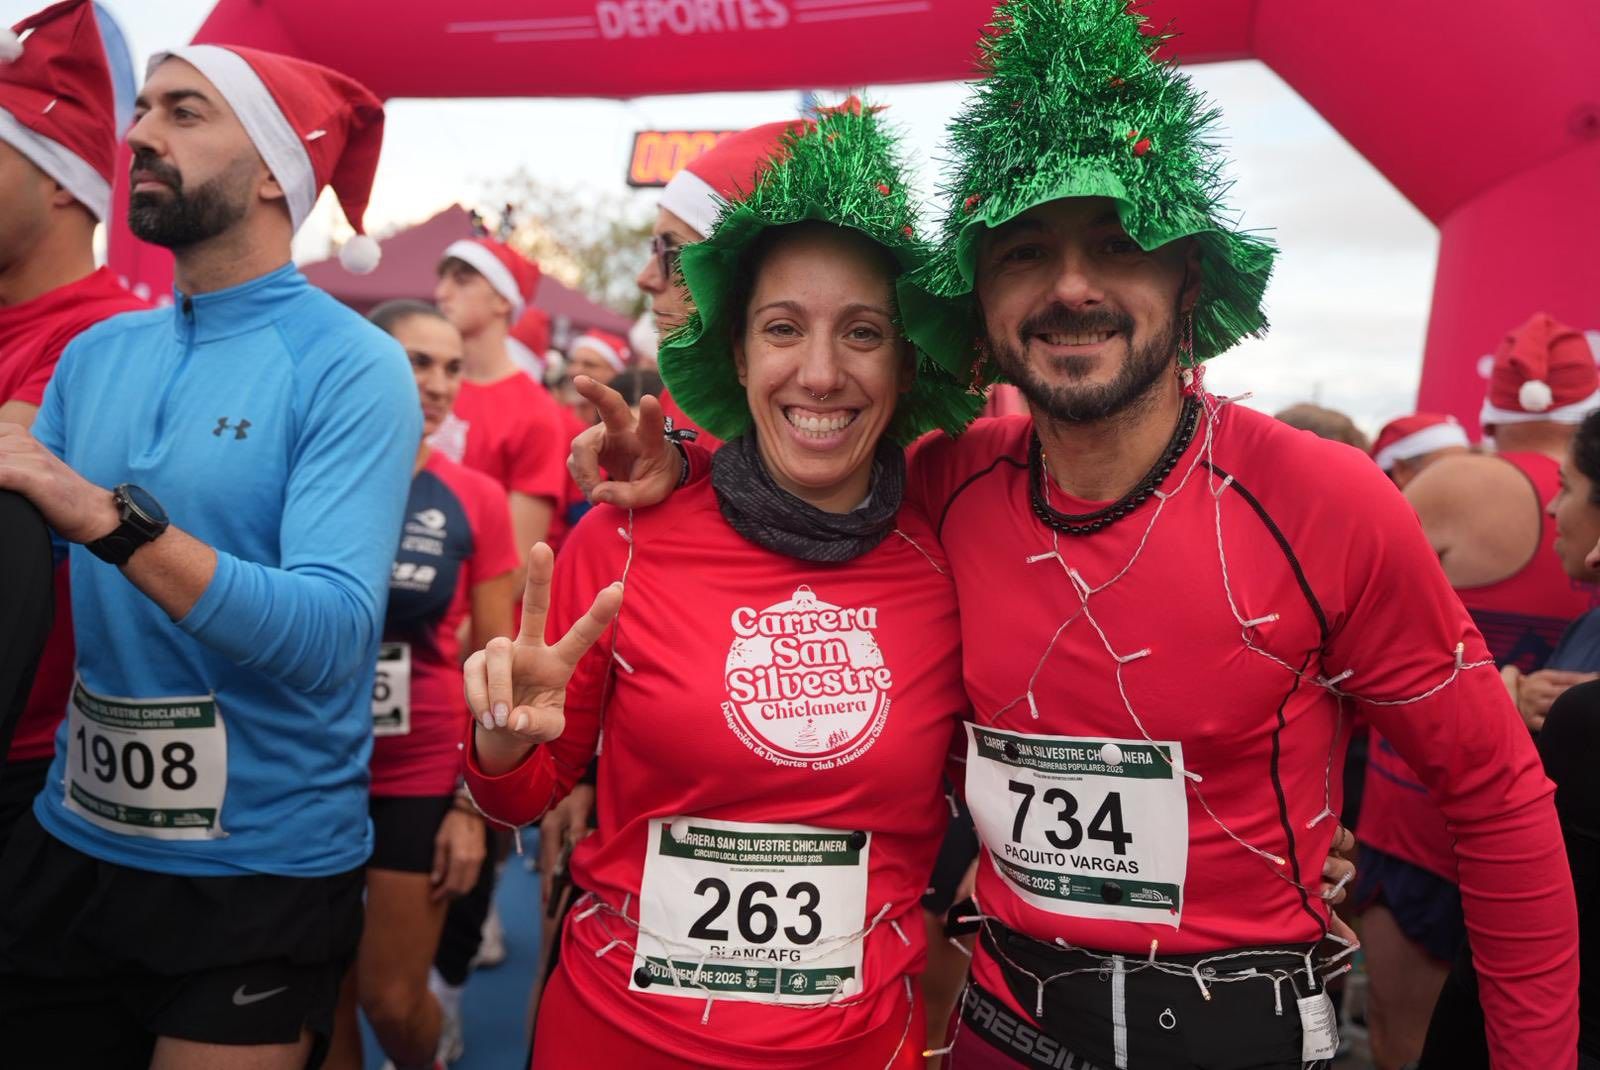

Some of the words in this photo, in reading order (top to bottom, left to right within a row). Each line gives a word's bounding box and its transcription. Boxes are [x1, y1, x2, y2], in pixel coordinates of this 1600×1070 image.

[596, 0, 789, 38] DEPORTES
[731, 606, 877, 637] Carrera
[773, 637, 848, 667] San
[729, 667, 892, 701] Silvestre
[761, 700, 866, 720] Chiclanera
[721, 702, 754, 750] Delegación
[754, 746, 765, 757] de
[765, 751, 808, 767] Deportes
[812, 760, 834, 771] Club
[836, 737, 875, 766] Atletismo
[872, 699, 891, 737] Chiclana
[77, 725, 197, 790] 1908
[1017, 743, 1033, 756] SAN
[1033, 745, 1085, 760] SILVESTRE
[1038, 760, 1067, 770] CARRERAS
[1068, 763, 1105, 772] POPULARES
[1106, 765, 1124, 773] 2025
[1008, 779, 1133, 855] 734
[694, 848, 719, 859] CIRCUITO
[720, 852, 738, 861] LOCAL
[739, 854, 772, 862] CARRERAS
[773, 854, 807, 863] POPULARES
[808, 855, 823, 863] 2025
[717, 836, 735, 849] SAN
[737, 839, 790, 852] SILVESTRE
[793, 840, 847, 853] CHICLANERA
[1004, 843, 1066, 867] PAQUITO
[1070, 853, 1139, 874] VARGAS
[1031, 876, 1057, 891] 2025
[687, 877, 822, 945] 263
[715, 972, 742, 984] 2025
